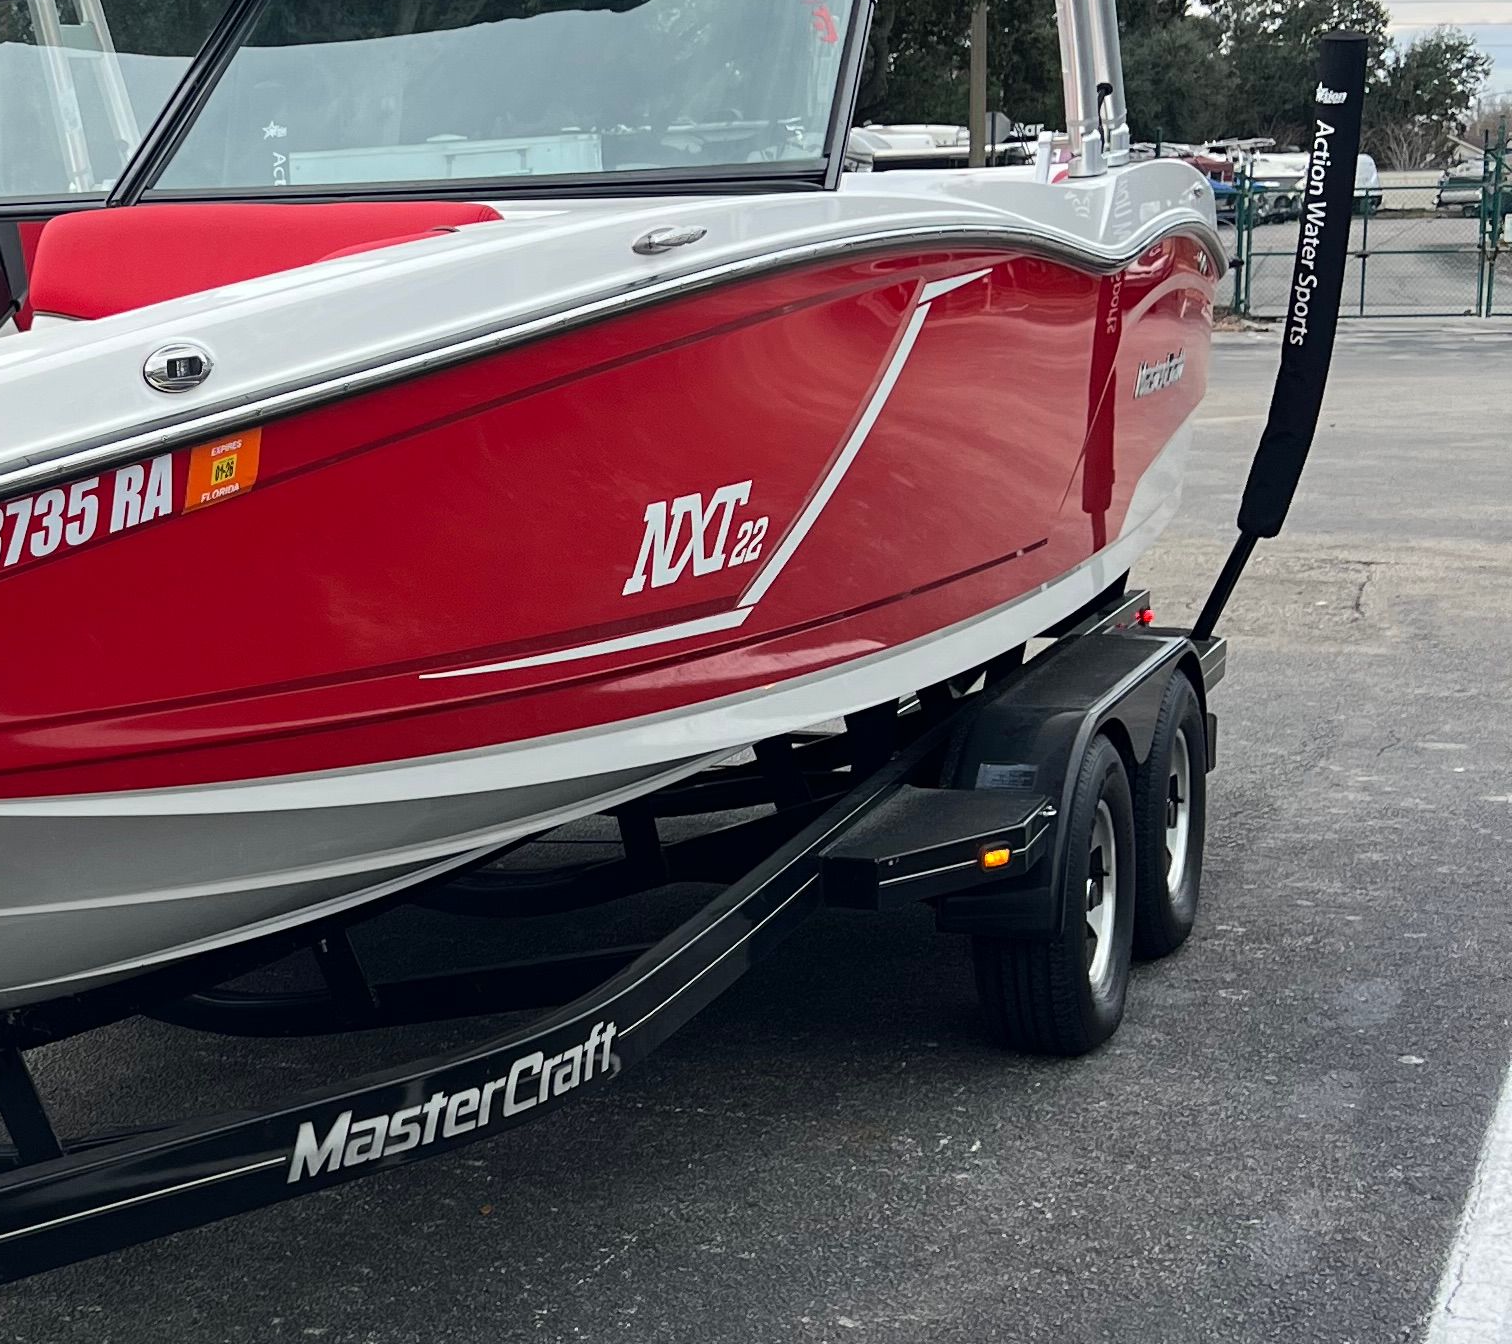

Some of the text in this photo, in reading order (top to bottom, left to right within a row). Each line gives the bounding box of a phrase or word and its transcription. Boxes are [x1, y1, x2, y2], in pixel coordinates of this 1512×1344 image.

[1289, 119, 1336, 346] Action Water Sports
[109, 453, 173, 534] RA
[200, 482, 240, 503] FLORIDA
[211, 439, 243, 457] EXPIRES
[622, 480, 769, 596] NXT 22
[287, 1021, 618, 1184] MasterCraft
